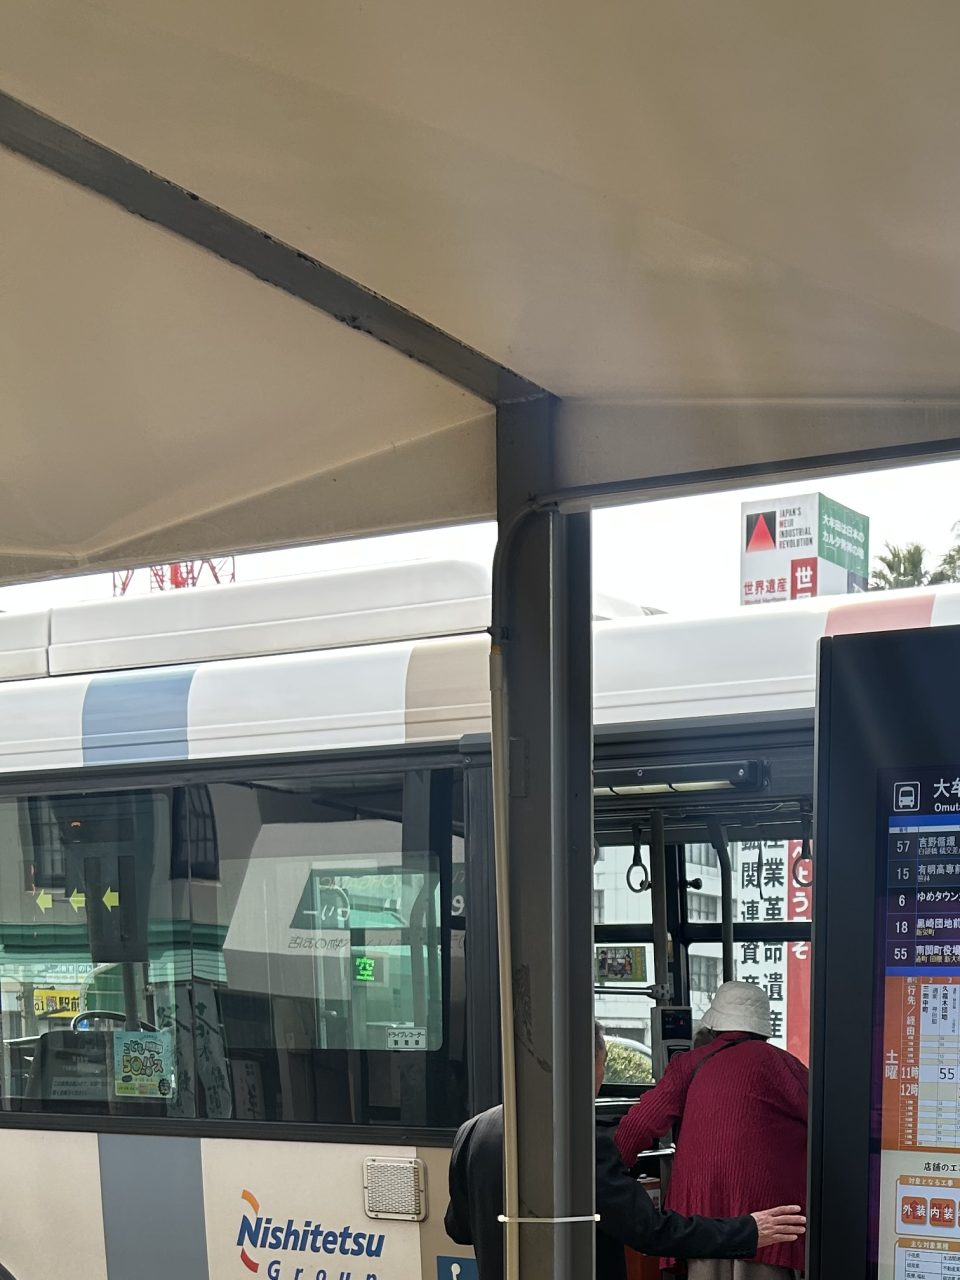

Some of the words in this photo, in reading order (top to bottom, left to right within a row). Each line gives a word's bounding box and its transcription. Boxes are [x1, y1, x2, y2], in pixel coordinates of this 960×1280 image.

[780, 507, 801, 518] JAPAN'S
[780, 527, 811, 538] INDUSTRIAL
[780, 537, 813, 548] REVOLUTION
[744, 578, 786, 595] 世界遺産
[897, 841, 910, 853] 57
[897, 868, 909, 880] 15
[899, 895, 905, 906] 6
[896, 922, 908, 933] 18
[894, 948, 907, 960] 55
[916, 945, 960, 956] 南関町役場
[885, 1050, 899, 1079] 土曜
[901, 1067, 919, 1079] 11時
[940, 1068, 955, 1079] 55
[901, 1083, 918, 1096] 12時
[903, 1204, 927, 1216] 外装
[931, 1207, 954, 1220] 内装
[237, 1214, 385, 1258] Nishitetsu
